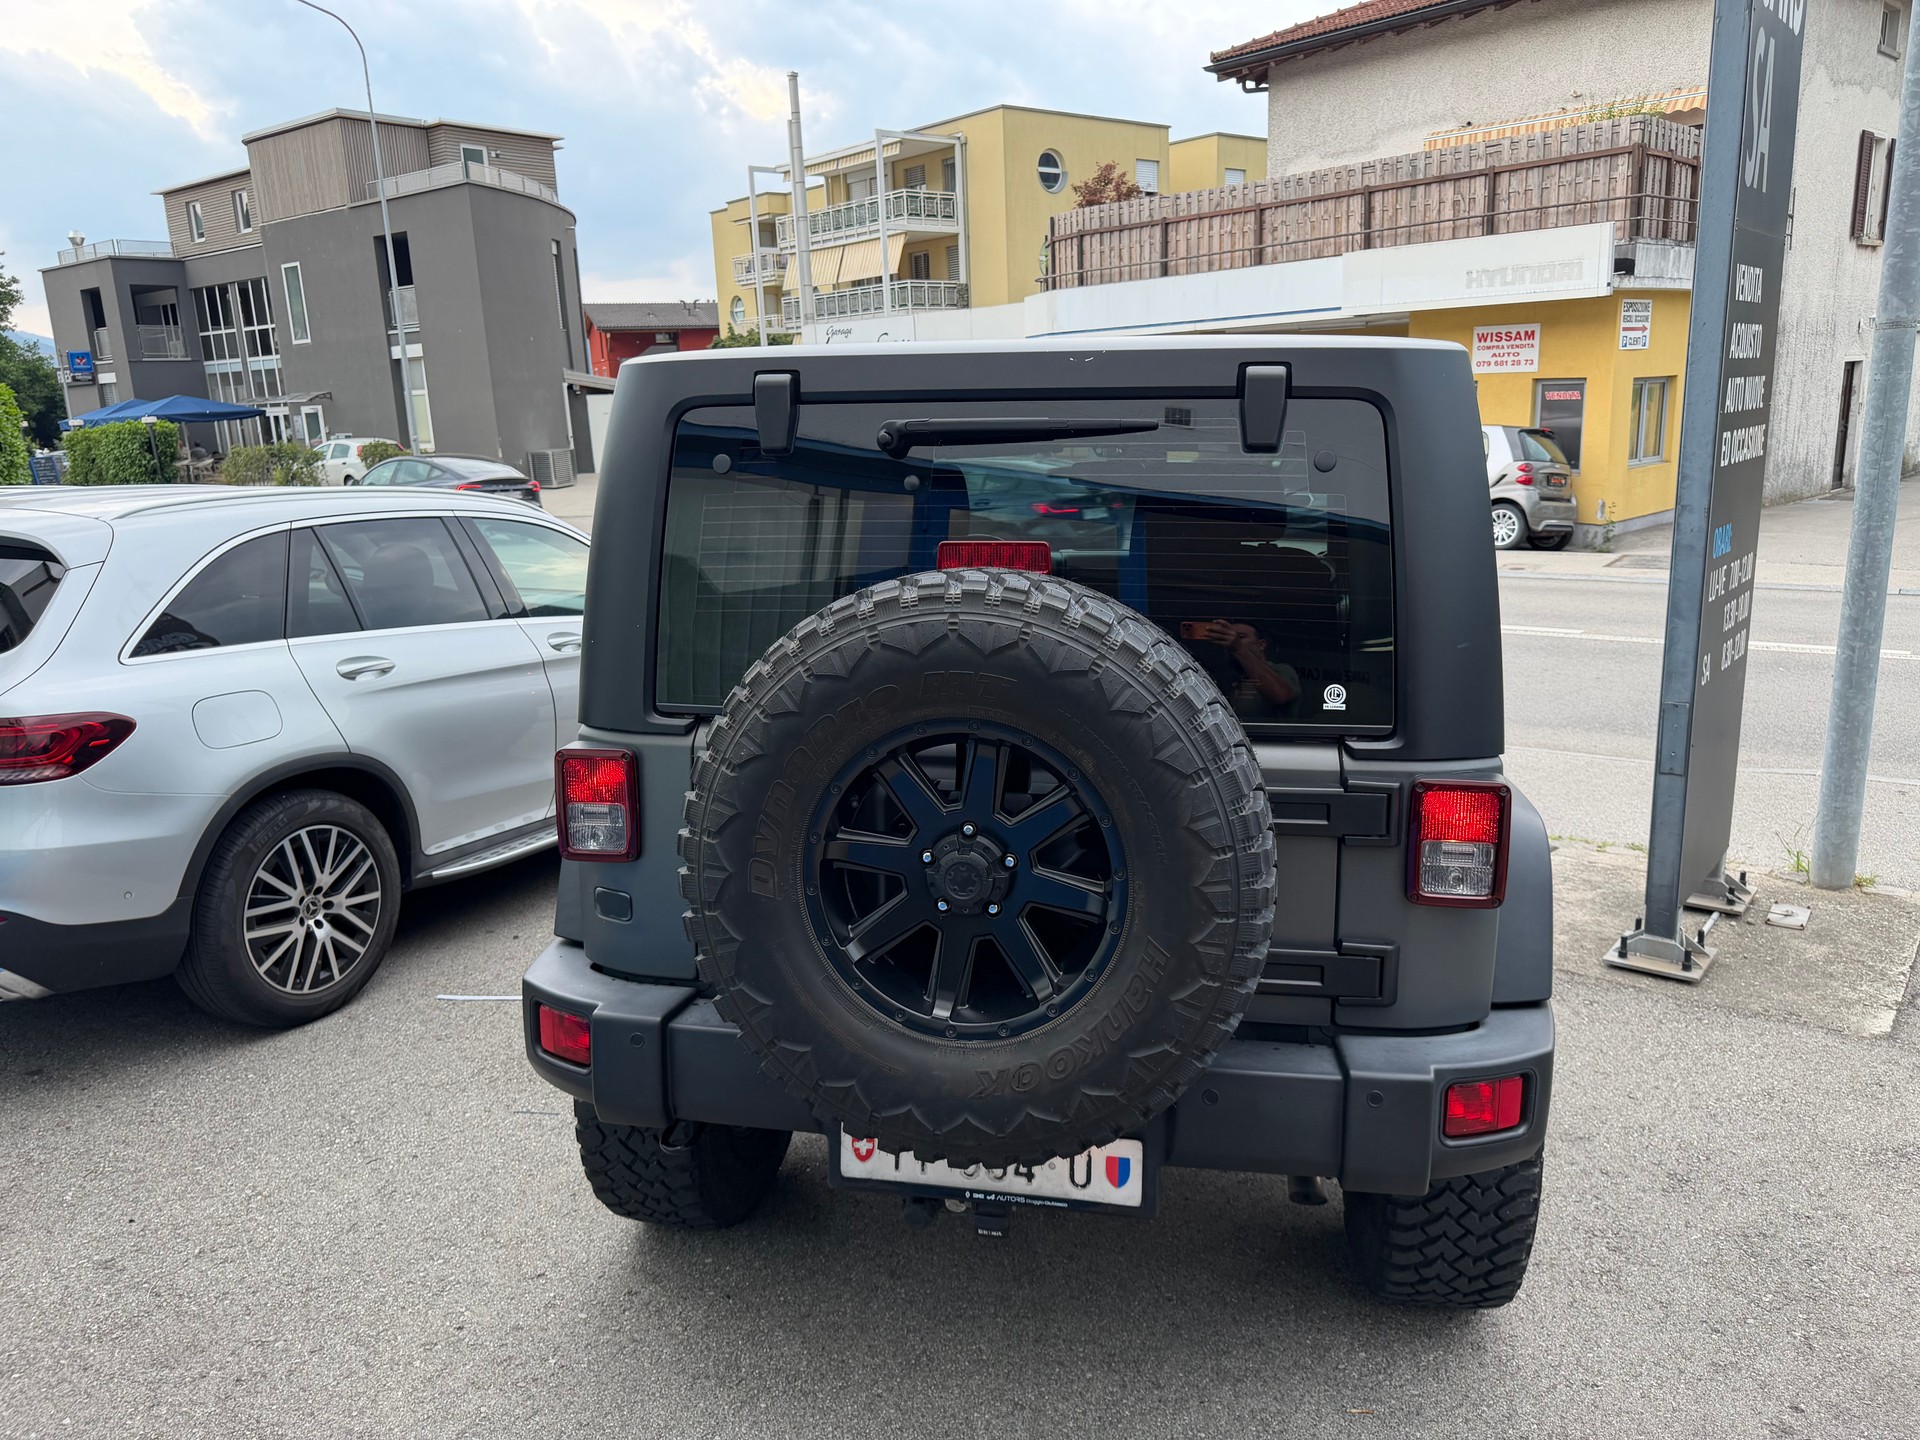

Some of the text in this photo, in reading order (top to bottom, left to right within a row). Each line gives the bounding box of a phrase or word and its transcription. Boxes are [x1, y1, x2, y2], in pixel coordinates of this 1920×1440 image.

[1744, 26, 1776, 193] SA
[1465, 259, 1584, 289] HYUNDAI
[1735, 263, 1763, 303] VENDITA
[826, 325, 852, 338] Garage
[1476, 329, 1536, 343] WISSAM
[1729, 322, 1763, 359] ACQUISTO
[1545, 390, 1581, 400] VENDITA
[1724, 375, 1766, 413] AUTO NUOVE
[1720, 424, 1766, 467] ED OCCASIONE
[1708, 564, 1728, 602] LU-VE
[1701, 652, 1711, 686] SA
[247, 812, 287, 854] PIRELLI
